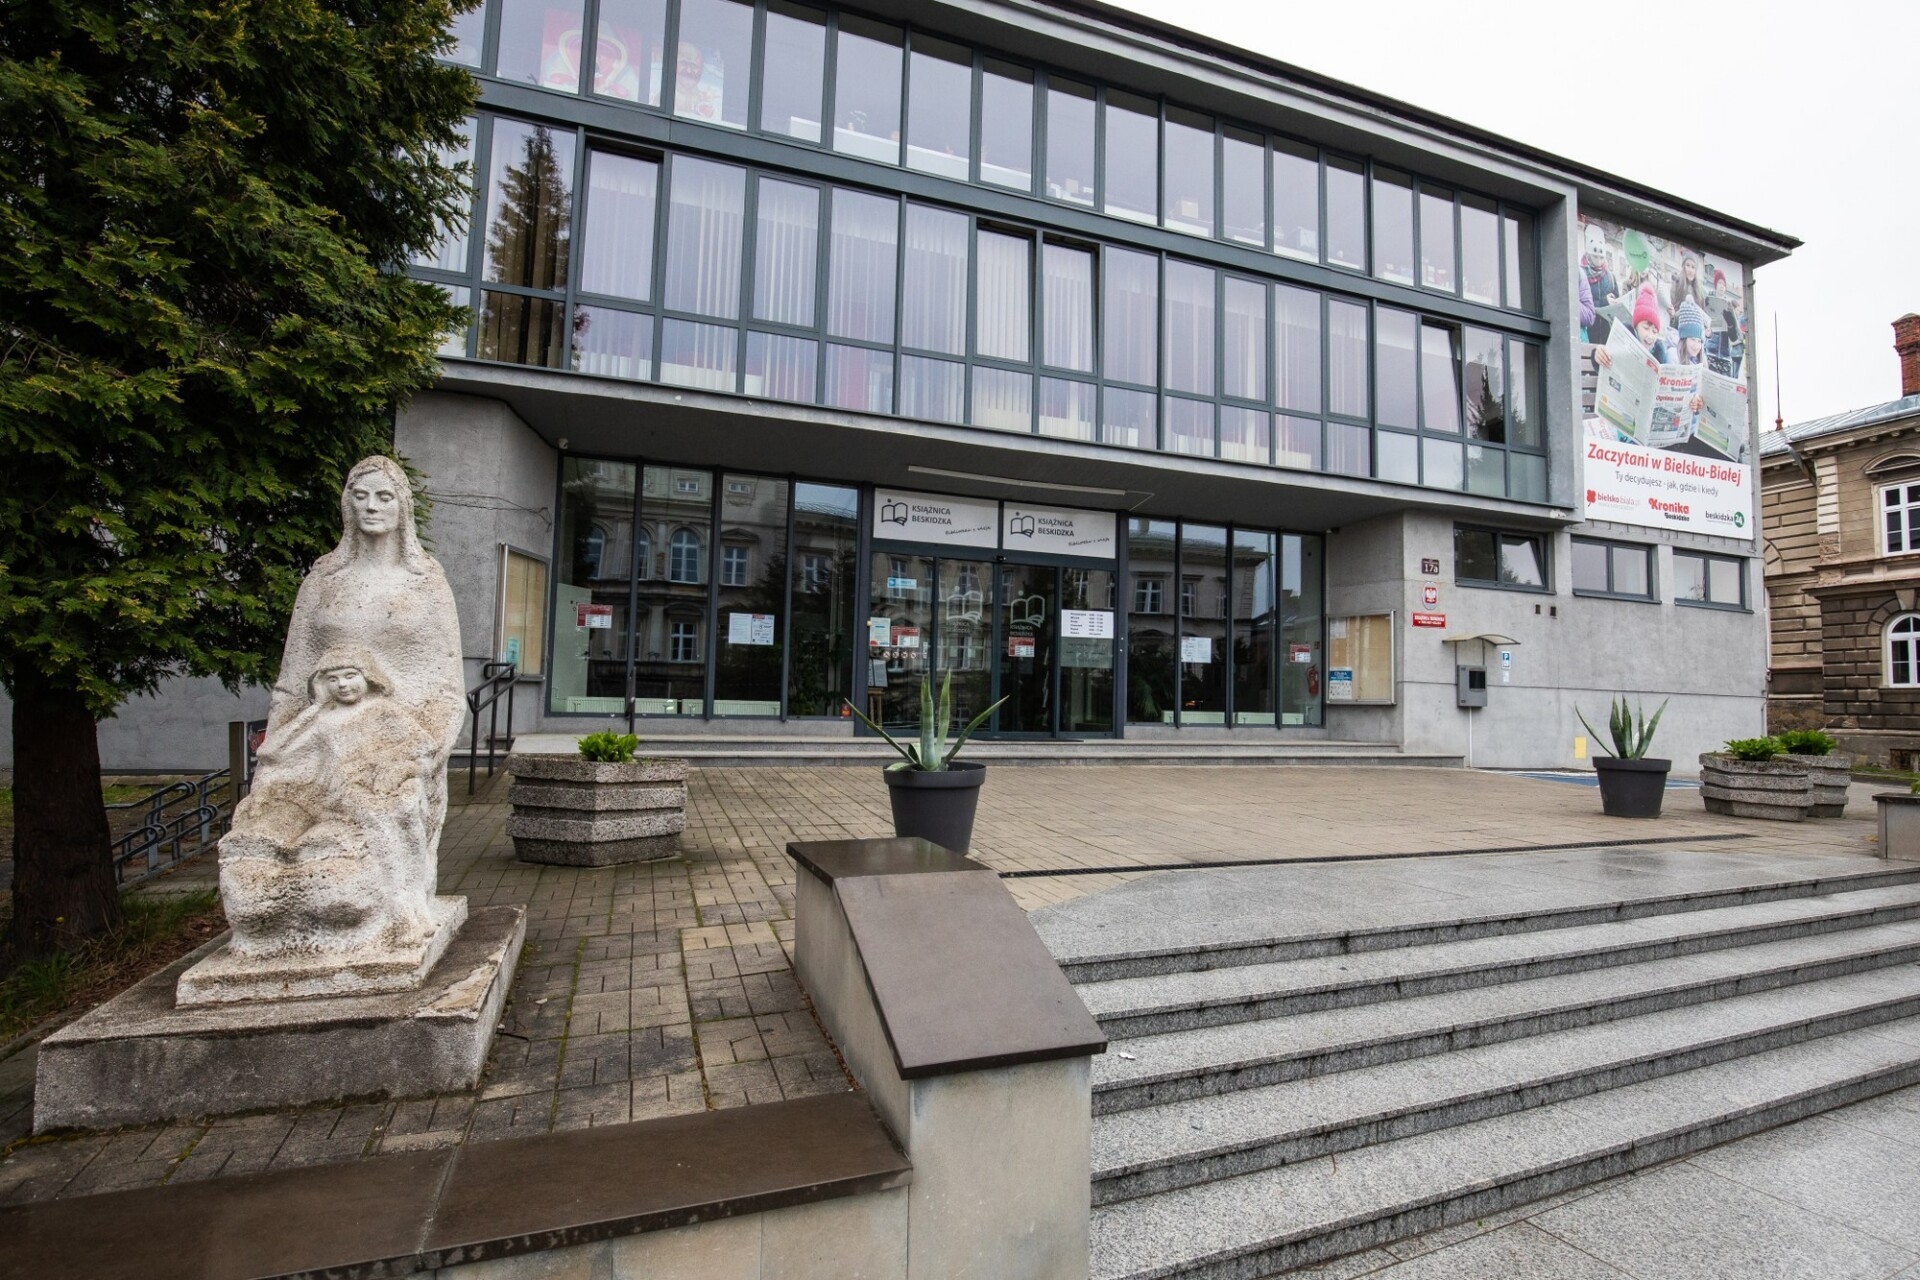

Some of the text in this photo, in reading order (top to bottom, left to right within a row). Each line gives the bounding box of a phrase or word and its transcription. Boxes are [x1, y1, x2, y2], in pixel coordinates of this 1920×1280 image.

[1588, 443, 1741, 487] Zaczytani w Bielsku-Białej
[1615, 471, 1623, 482] Ty
[1624, 473, 1662, 488] decydujesz
[1666, 480, 1678, 490] jak,
[1679, 481, 1697, 493] gdzie
[1701, 484, 1719, 497] kiedy
[912, 504, 951, 515] KSIĄŻNICA
[1648, 498, 1690, 514] Kronika
[912, 515, 952, 525] BESKIDZKA
[1038, 518, 1074, 528] KSIĄŻNICA
[1038, 528, 1075, 537] BESKIDZKA
[1424, 563, 1438, 574] 17a
